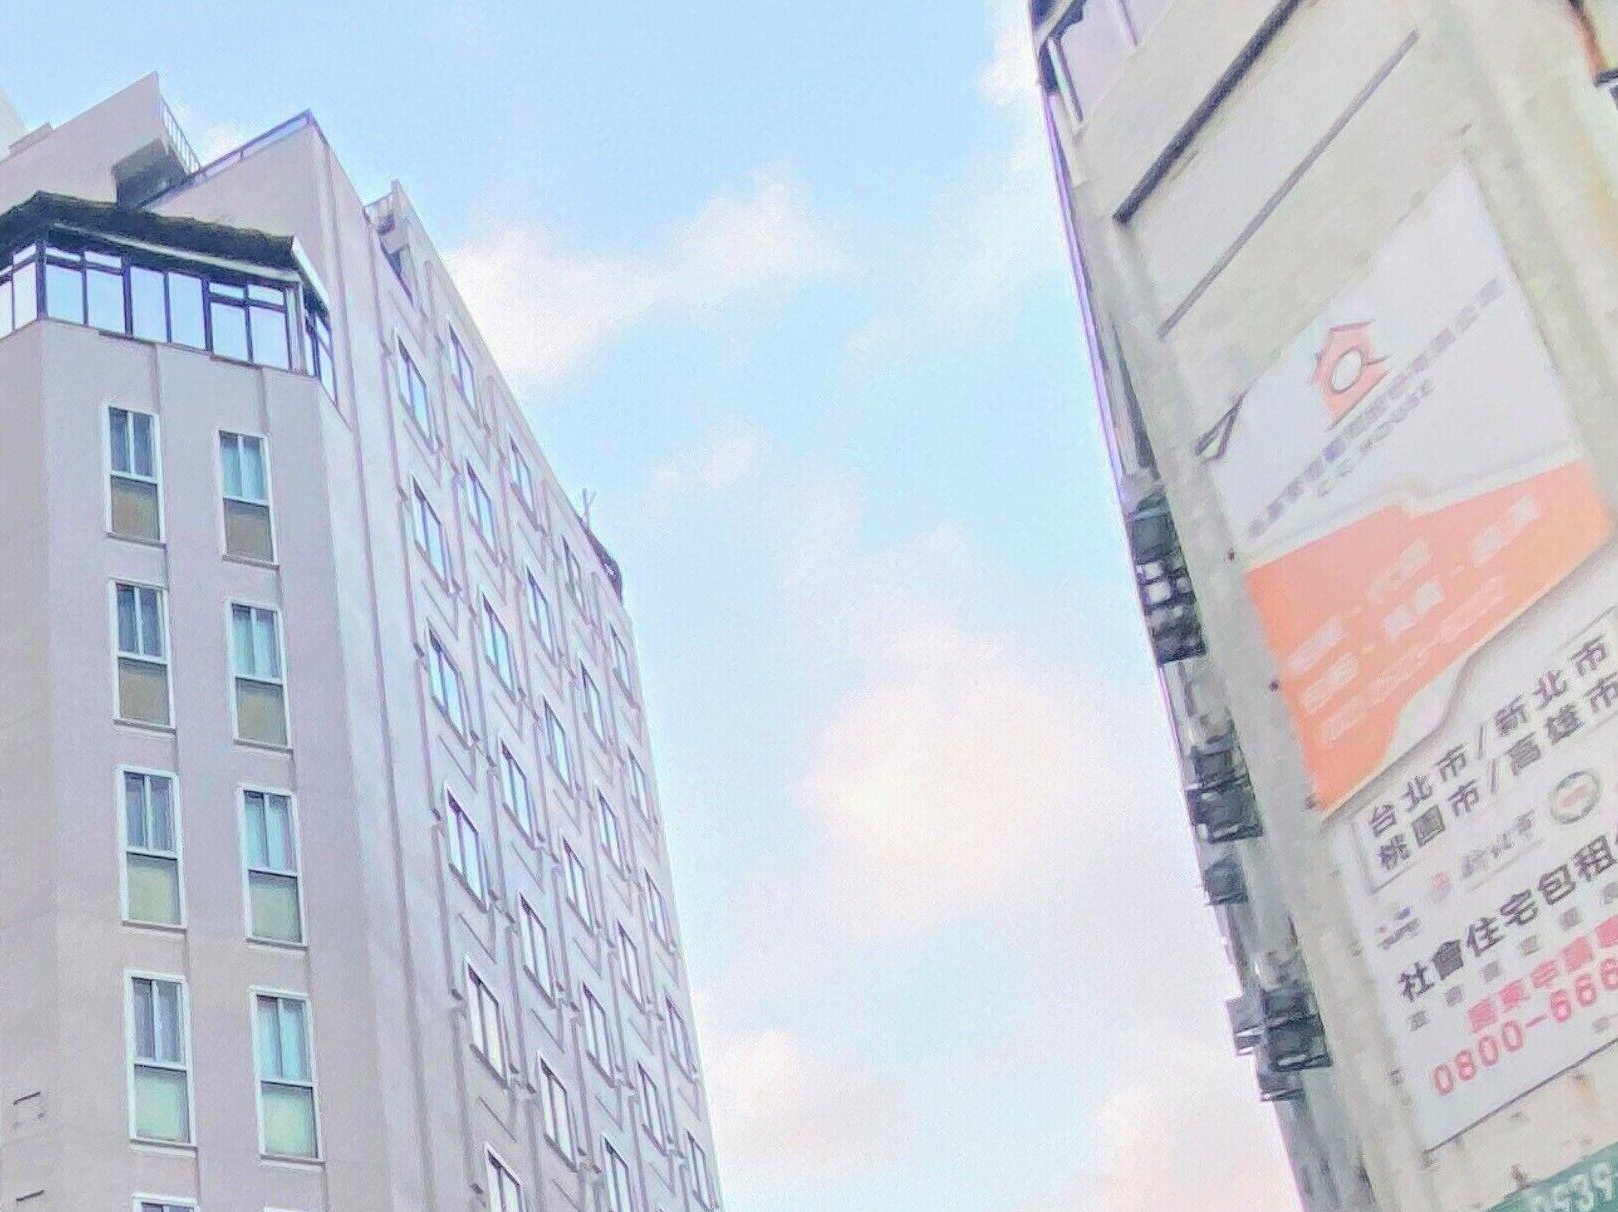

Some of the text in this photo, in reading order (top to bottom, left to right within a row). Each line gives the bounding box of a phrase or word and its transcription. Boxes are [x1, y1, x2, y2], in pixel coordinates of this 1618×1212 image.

[1368, 633, 1609, 837] 台北市/新北市
[1398, 828, 1618, 1003] 社會住宅包租
